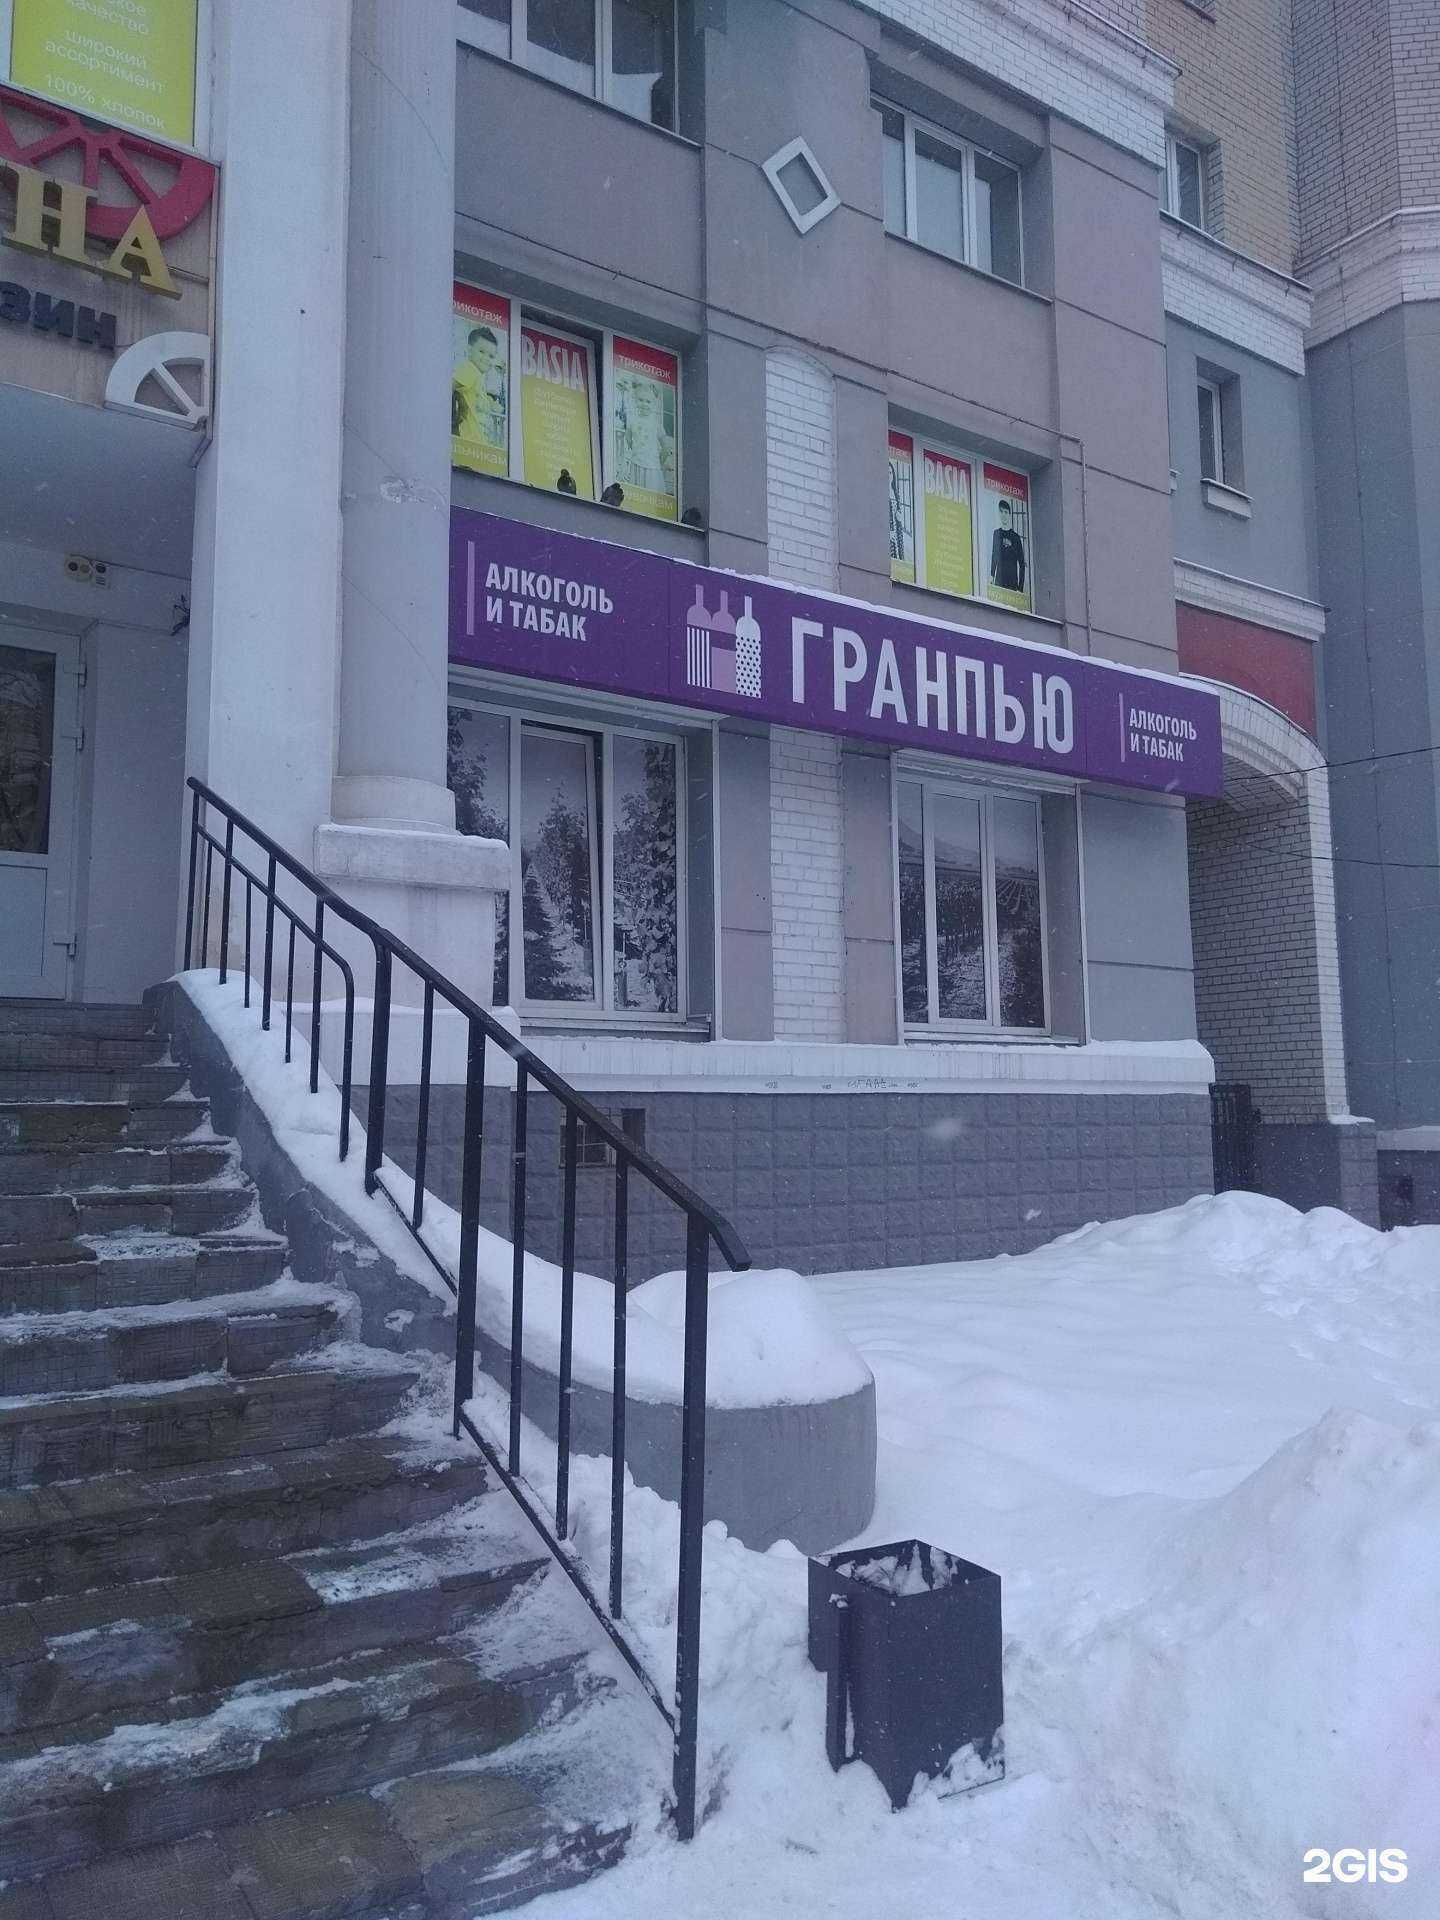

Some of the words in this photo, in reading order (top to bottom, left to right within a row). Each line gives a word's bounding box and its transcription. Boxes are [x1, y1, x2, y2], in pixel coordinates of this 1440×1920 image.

[45, 40, 167, 96] ассортимент
[64, 29, 147, 70] широкий
[45, 74, 96, 104] 100%
[101, 96, 165, 129] хлопок
[522, 334, 585, 390] BASIA
[618, 353, 672, 381] трикотаж
[925, 456, 969, 506] BASIA
[485, 562, 614, 614] АЛКОГОЛЬ
[486, 595, 503, 624] И
[509, 600, 587, 642] ТАБАК
[791, 616, 1074, 754] ГРАНПЬЮ
[1129, 707, 1197, 741] АЛКОГОЛЬ
[1130, 732, 1140, 753] И
[1142, 735, 1184, 762] ТАБАК
